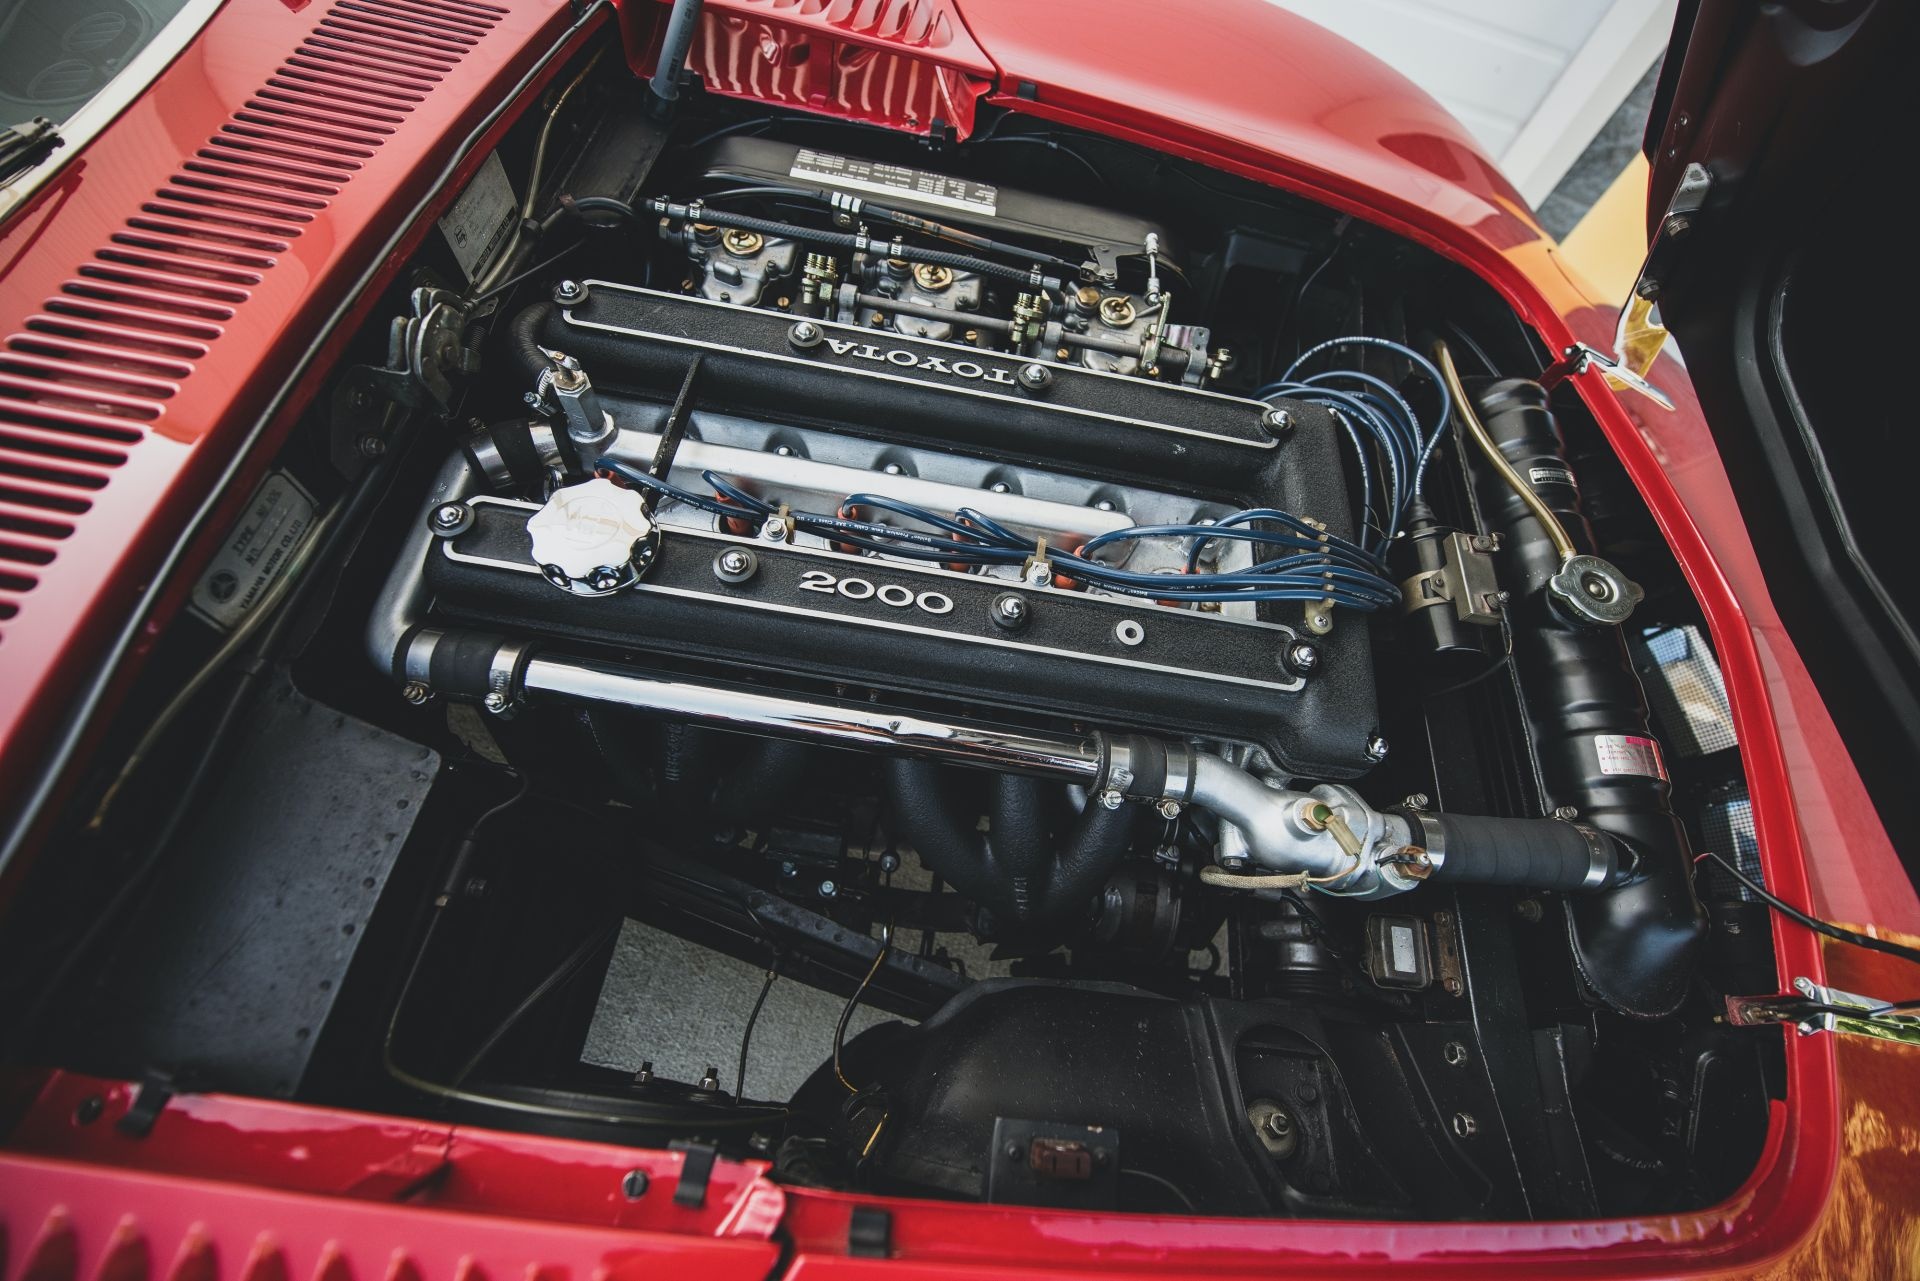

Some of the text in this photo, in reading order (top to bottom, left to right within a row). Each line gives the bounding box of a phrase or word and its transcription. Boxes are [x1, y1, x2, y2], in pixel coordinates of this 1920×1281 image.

[824, 338, 1015, 385] TOYOTA
[240, 576, 266, 610] YAMAHA
[263, 549, 284, 575] MOTOR
[799, 571, 954, 614] 2000
